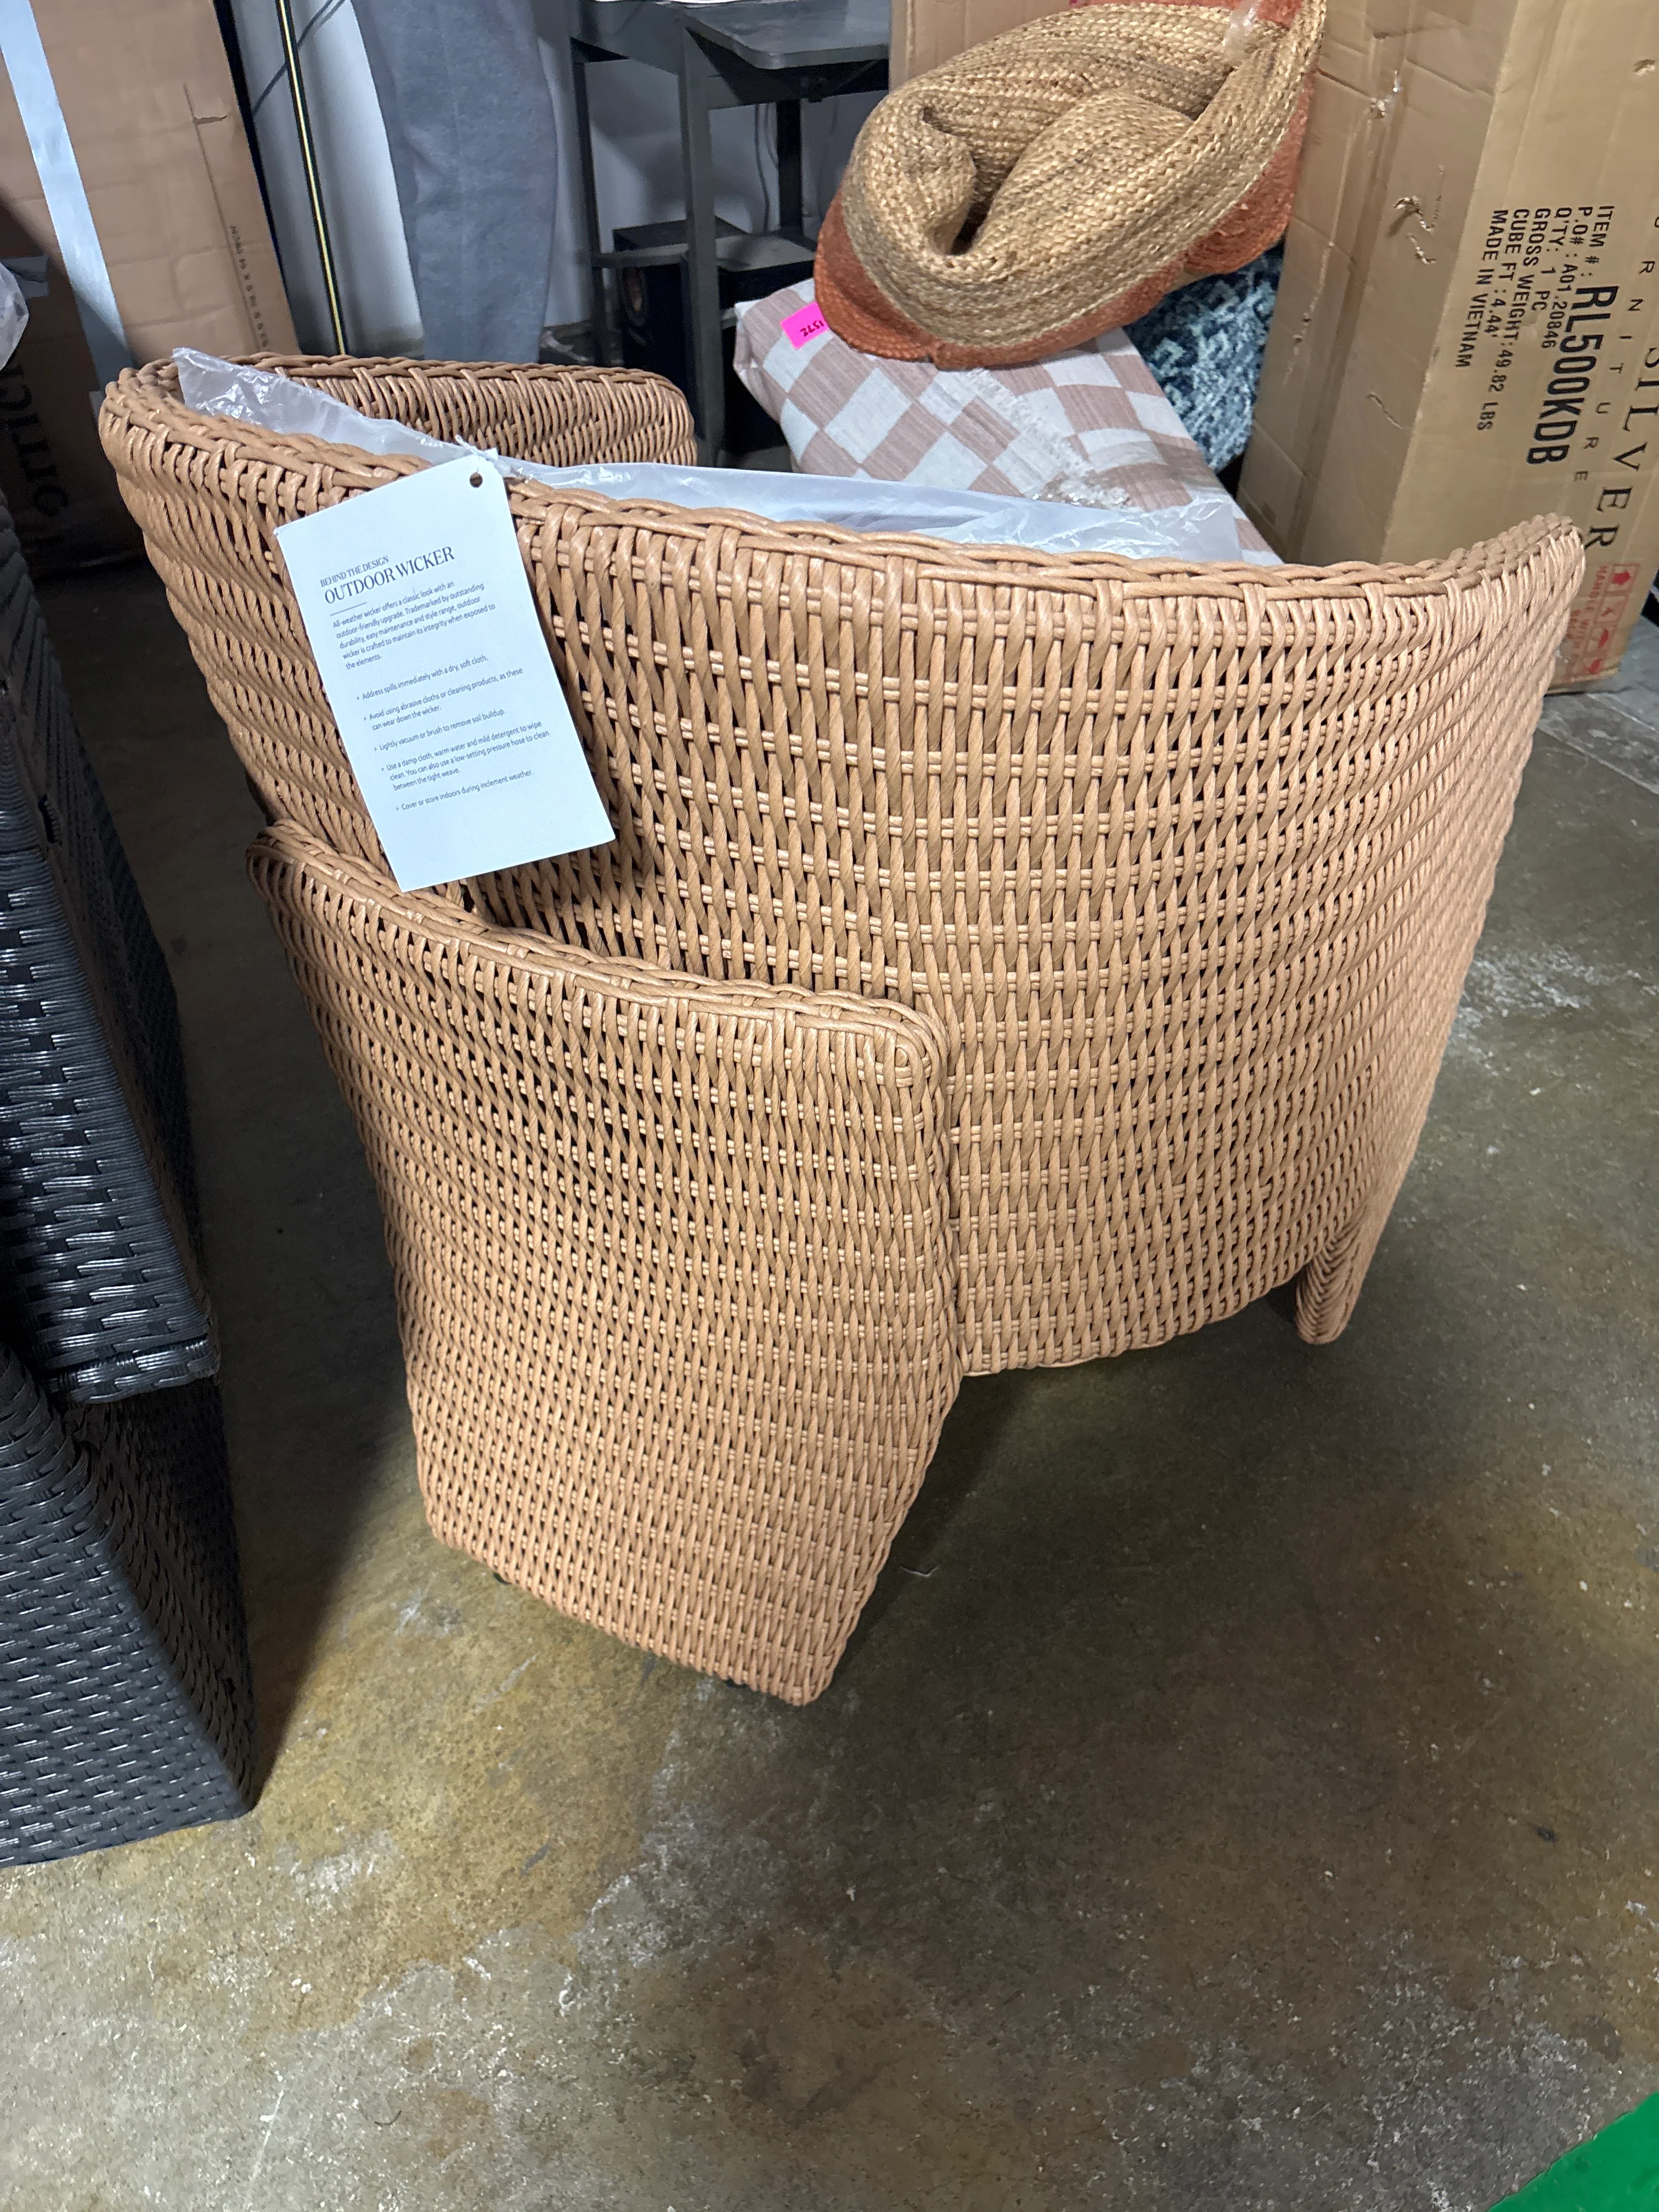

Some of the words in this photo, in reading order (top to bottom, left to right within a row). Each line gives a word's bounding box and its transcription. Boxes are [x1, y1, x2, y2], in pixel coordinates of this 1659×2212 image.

[1481, 210, 1509, 261] MADE
[1504, 208, 1530, 254] CUBE
[1522, 208, 1551, 266] GROSS
[1546, 207, 1572, 252] Q'TY:
[1570, 206, 1593, 245] P.O#
[1589, 206, 1615, 247] ITEM
[1475, 268, 1494, 285] IN
[1498, 262, 1517, 281] FT
[1531, 291, 1550, 311] PC
[1455, 294, 1488, 368] VIETNAM
[1526, 286, 1620, 465] RL500KDB
[1477, 402, 1498, 431] LBS
[320, 572, 347, 588] BEHIND
[346, 565, 363, 577] THE
[363, 555, 388, 571] DESIGN
[324, 567, 396, 604] OUTDOOR
[395, 546, 455, 577] WICKER
[333, 613, 363, 629] All-weather
[363, 607, 381, 618] wicker
[381, 601, 398, 611] offers
[402, 591, 421, 604] classic
[419, 587, 434, 597] look
[433, 583, 447, 593] with
[336, 618, 380, 639] outdoor-friendly
[380, 610, 405, 624] upgrade.
[404, 596, 442, 615] Trademarked
[441, 595, 449, 603] by
[449, 583, 485, 600] outstanding
[339, 636, 366, 649] durability,
[365, 631, 378, 641] easy
[378, 619, 414, 636] maintenance
[414, 614, 425, 624] and
[424, 610, 438, 620] style
[438, 605, 457, 616] range,
[456, 596, 481, 610] outdoor
[342, 649, 360, 660] wicker
[365, 639, 386, 652] crafted
[392, 630, 416, 643] maintain
[422, 619, 447, 633] integrity
[447, 614, 464, 624] when
[464, 603, 488, 619] exposed
[345, 662, 356, 670] the
[356, 654, 382, 667] elements.
[362, 689, 384, 701] Address
[383, 682, 398, 694] spills
[397, 672, 431, 689] immediately
[431, 668, 444, 678] with
[448, 664, 460, 673] dry,
[460, 659, 472, 669] soft
[471, 654, 489, 665] cloth.
[369, 709, 385, 721] Avoid
[385, 706, 400, 715] using
[400, 699, 422, 711] abrasive
[422, 693, 440, 704] cloths
[447, 684, 472, 696] cleaning
[471, 676, 499, 690] products,
[505, 668, 523, 678] these
[381, 719, 396, 727] wear
[396, 714, 412, 724] down
[411, 710, 422, 719] the
[421, 705, 442, 715] wicker.
[379, 740, 398, 751] Lightly
[397, 735, 420, 745] vacuum
[425, 726, 443, 737] brush
[450, 719, 472, 730] remove
[471, 713, 482, 724] soil
[481, 709, 506, 720] buildup.
[401, 758, 417, 766] damp
[417, 752, 435, 762] cloth,
[433, 748, 450, 757] warm
[449, 743, 466, 753] water
[466, 738, 478, 748] and
[477, 733, 491, 744] mild
[490, 727, 520, 741] detergent
[527, 721, 542, 730] wipe
[390, 772, 407, 781] clean.
[428, 762, 439, 770] also
[453, 749, 487, 763] low-setting
[486, 742, 511, 755] pressure
[510, 737, 526, 747] hose
[533, 731, 550, 741] clean
[392, 780, 417, 791] between
[416, 776, 427, 785] the
[427, 772, 442, 782] tight
[441, 768, 461, 777] weave.
[401, 802, 417, 810] Cover
[424, 795, 439, 804] store
[438, 789, 461, 800] indoors
[461, 785, 481, 794] during
[479, 776, 509, 789] inclement
[508, 770, 534, 782] weather.
